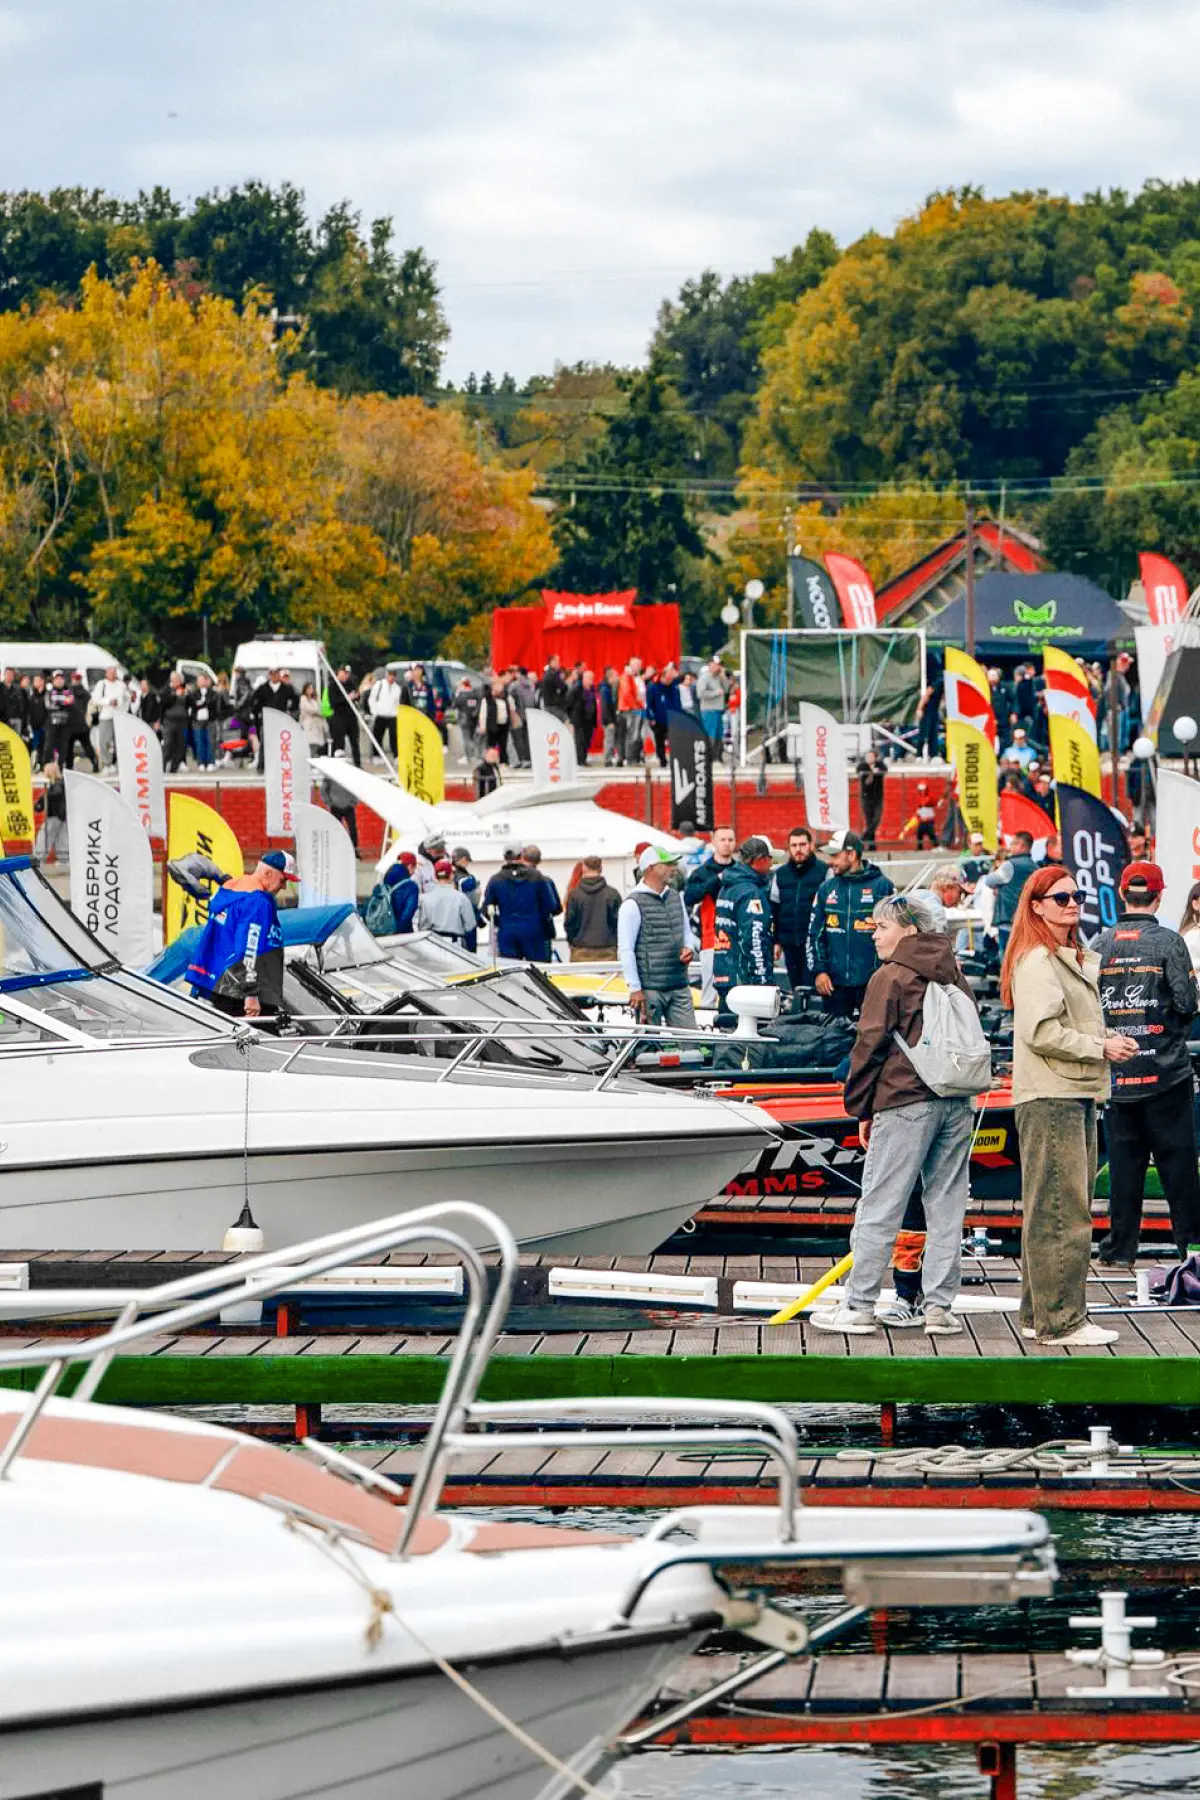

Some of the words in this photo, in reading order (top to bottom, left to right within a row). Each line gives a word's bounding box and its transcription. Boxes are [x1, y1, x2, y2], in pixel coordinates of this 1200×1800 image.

[965, 742, 980, 810] BETBOOM
[86, 818, 102, 933] ФАБРИКА
[104, 854, 119, 935] ЛОДОК
